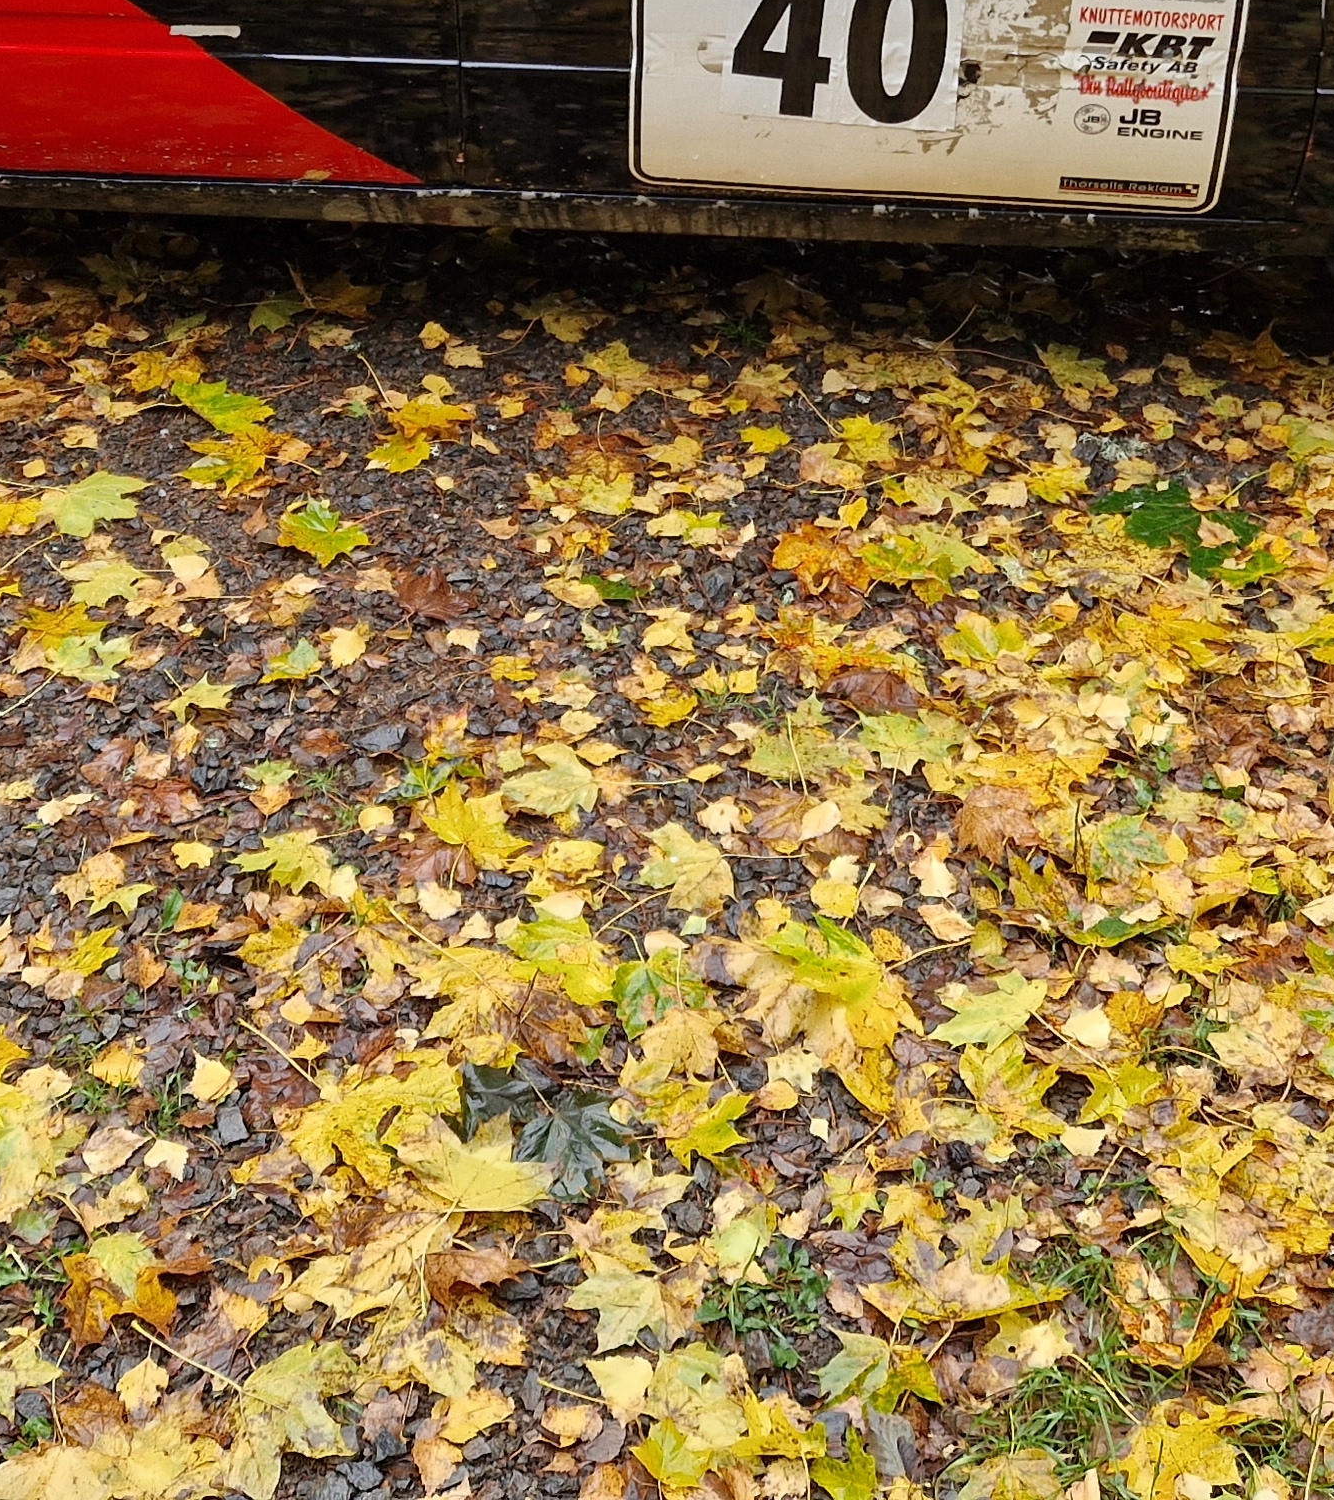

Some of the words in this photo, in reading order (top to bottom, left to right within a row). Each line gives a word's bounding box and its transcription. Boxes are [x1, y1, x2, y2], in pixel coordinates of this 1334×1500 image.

[1079, 6, 1225, 31] KNUTTEMOTORSPORT
[1116, 32, 1216, 60] KBT
[1092, 56, 1162, 75] Safety
[1167, 61, 1198, 73] AB
[1120, 108, 1162, 125] JB
[1117, 127, 1203, 140] ENGINE
